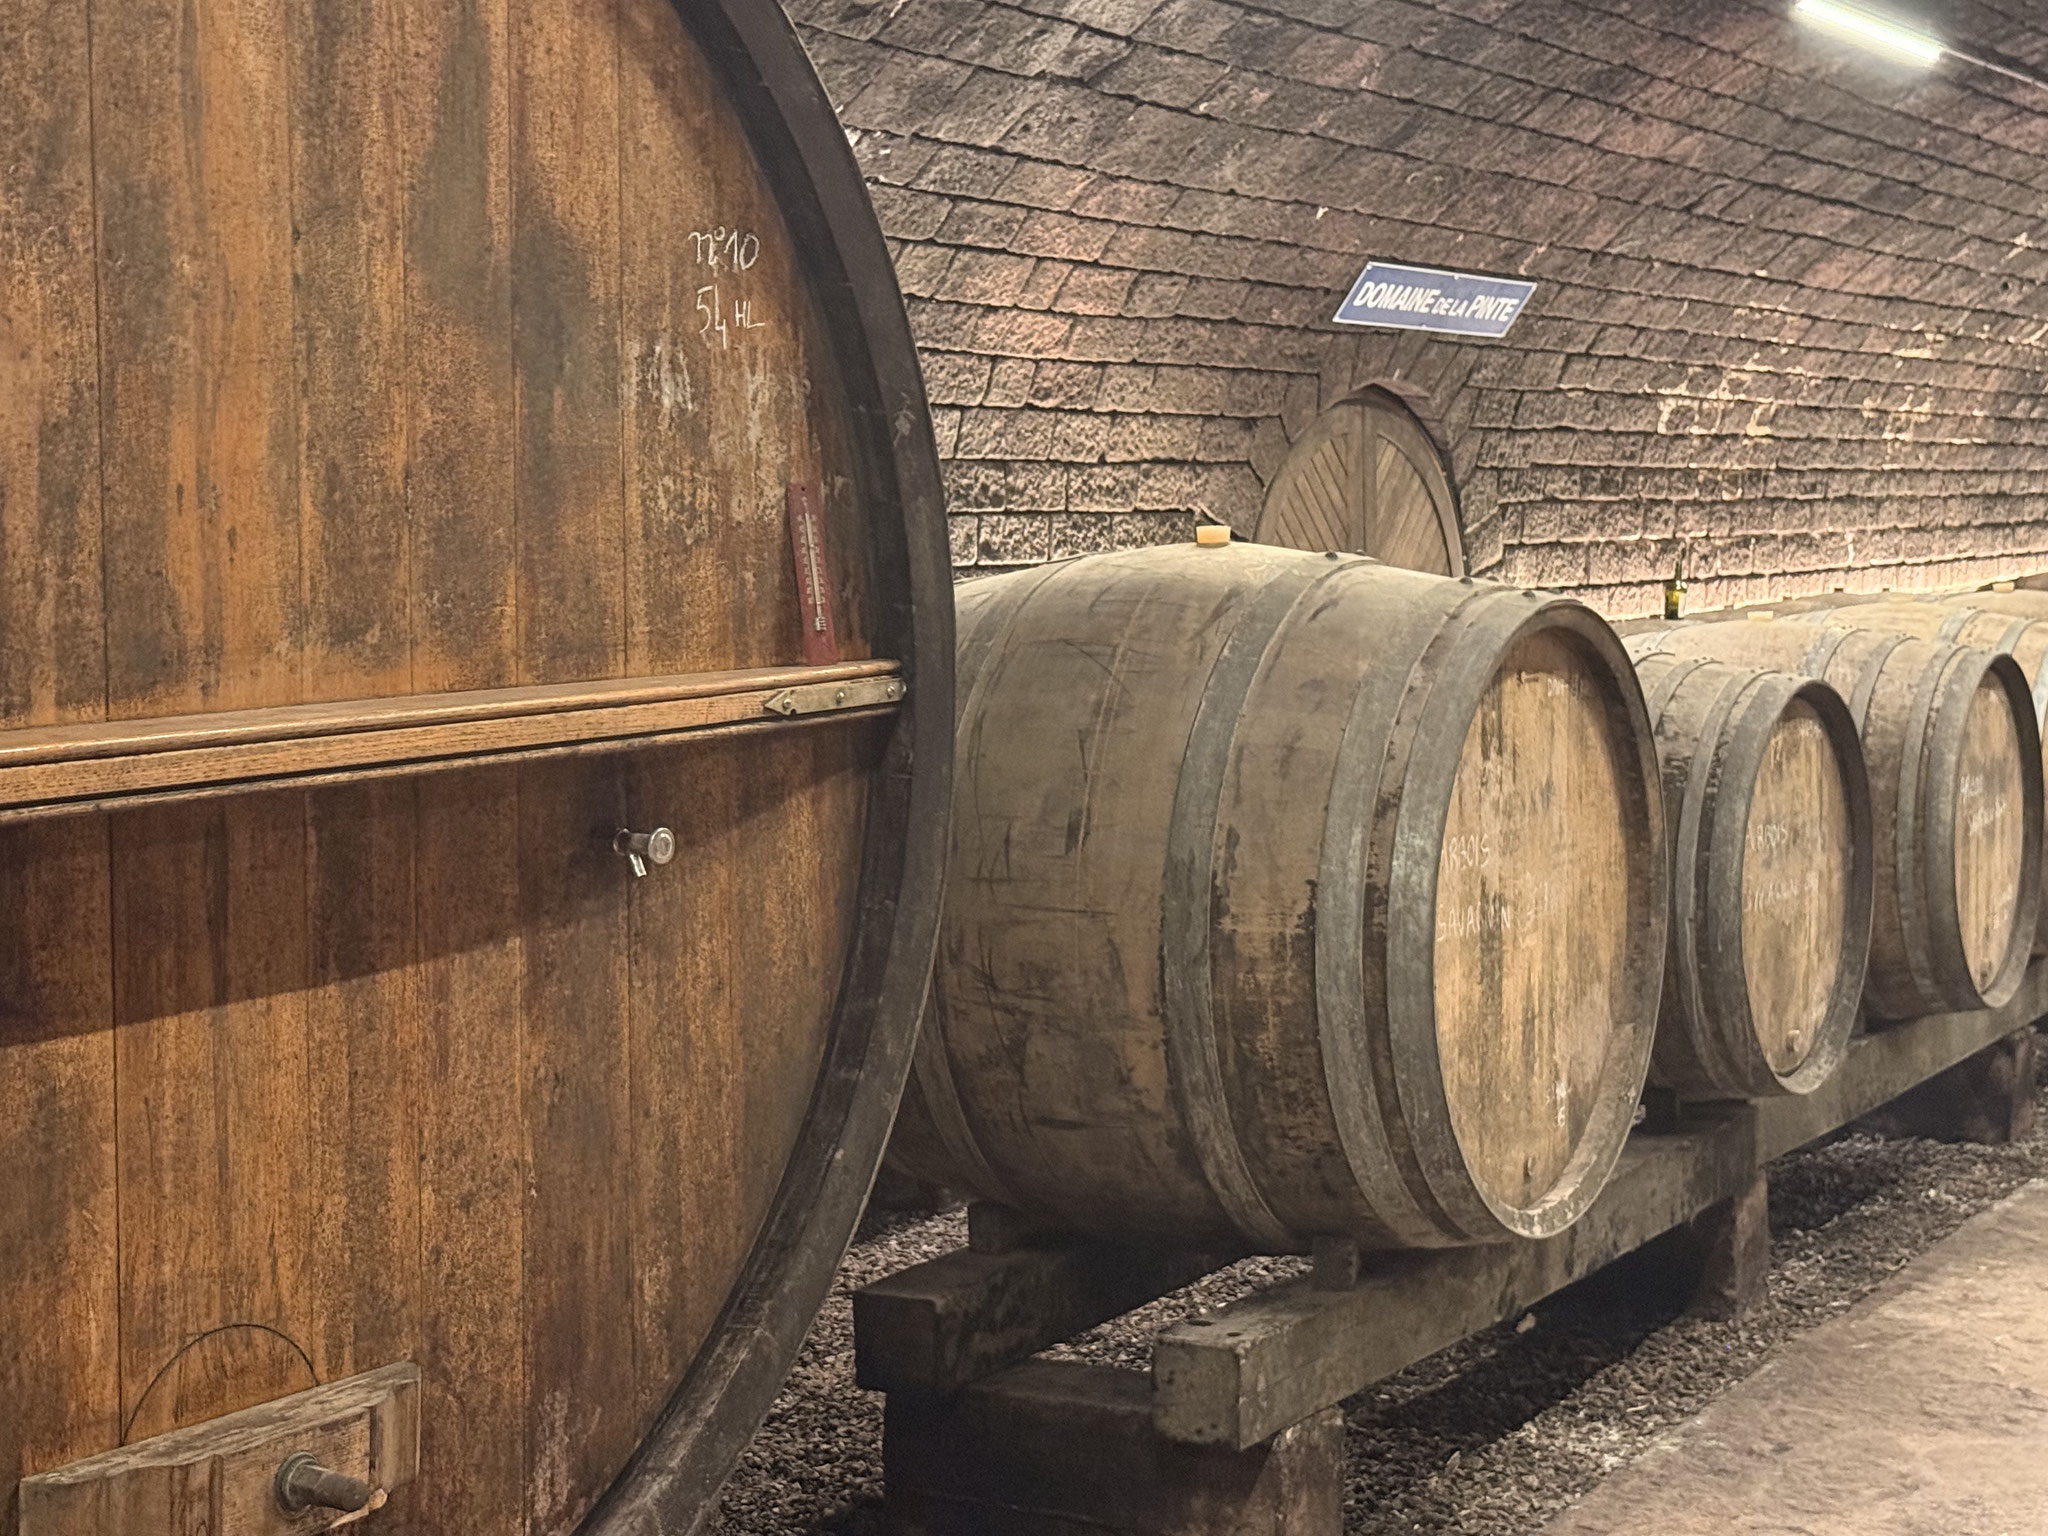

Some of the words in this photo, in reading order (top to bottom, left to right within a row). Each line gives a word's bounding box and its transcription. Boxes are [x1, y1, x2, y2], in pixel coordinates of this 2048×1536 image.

[697, 285, 727, 350] 54
[735, 300, 766, 329] HL
[1353, 281, 1441, 314] DOMAINE
[1431, 297, 1452, 316] DE
[1452, 300, 1466, 316] LA
[1464, 294, 1519, 322] PINTE
